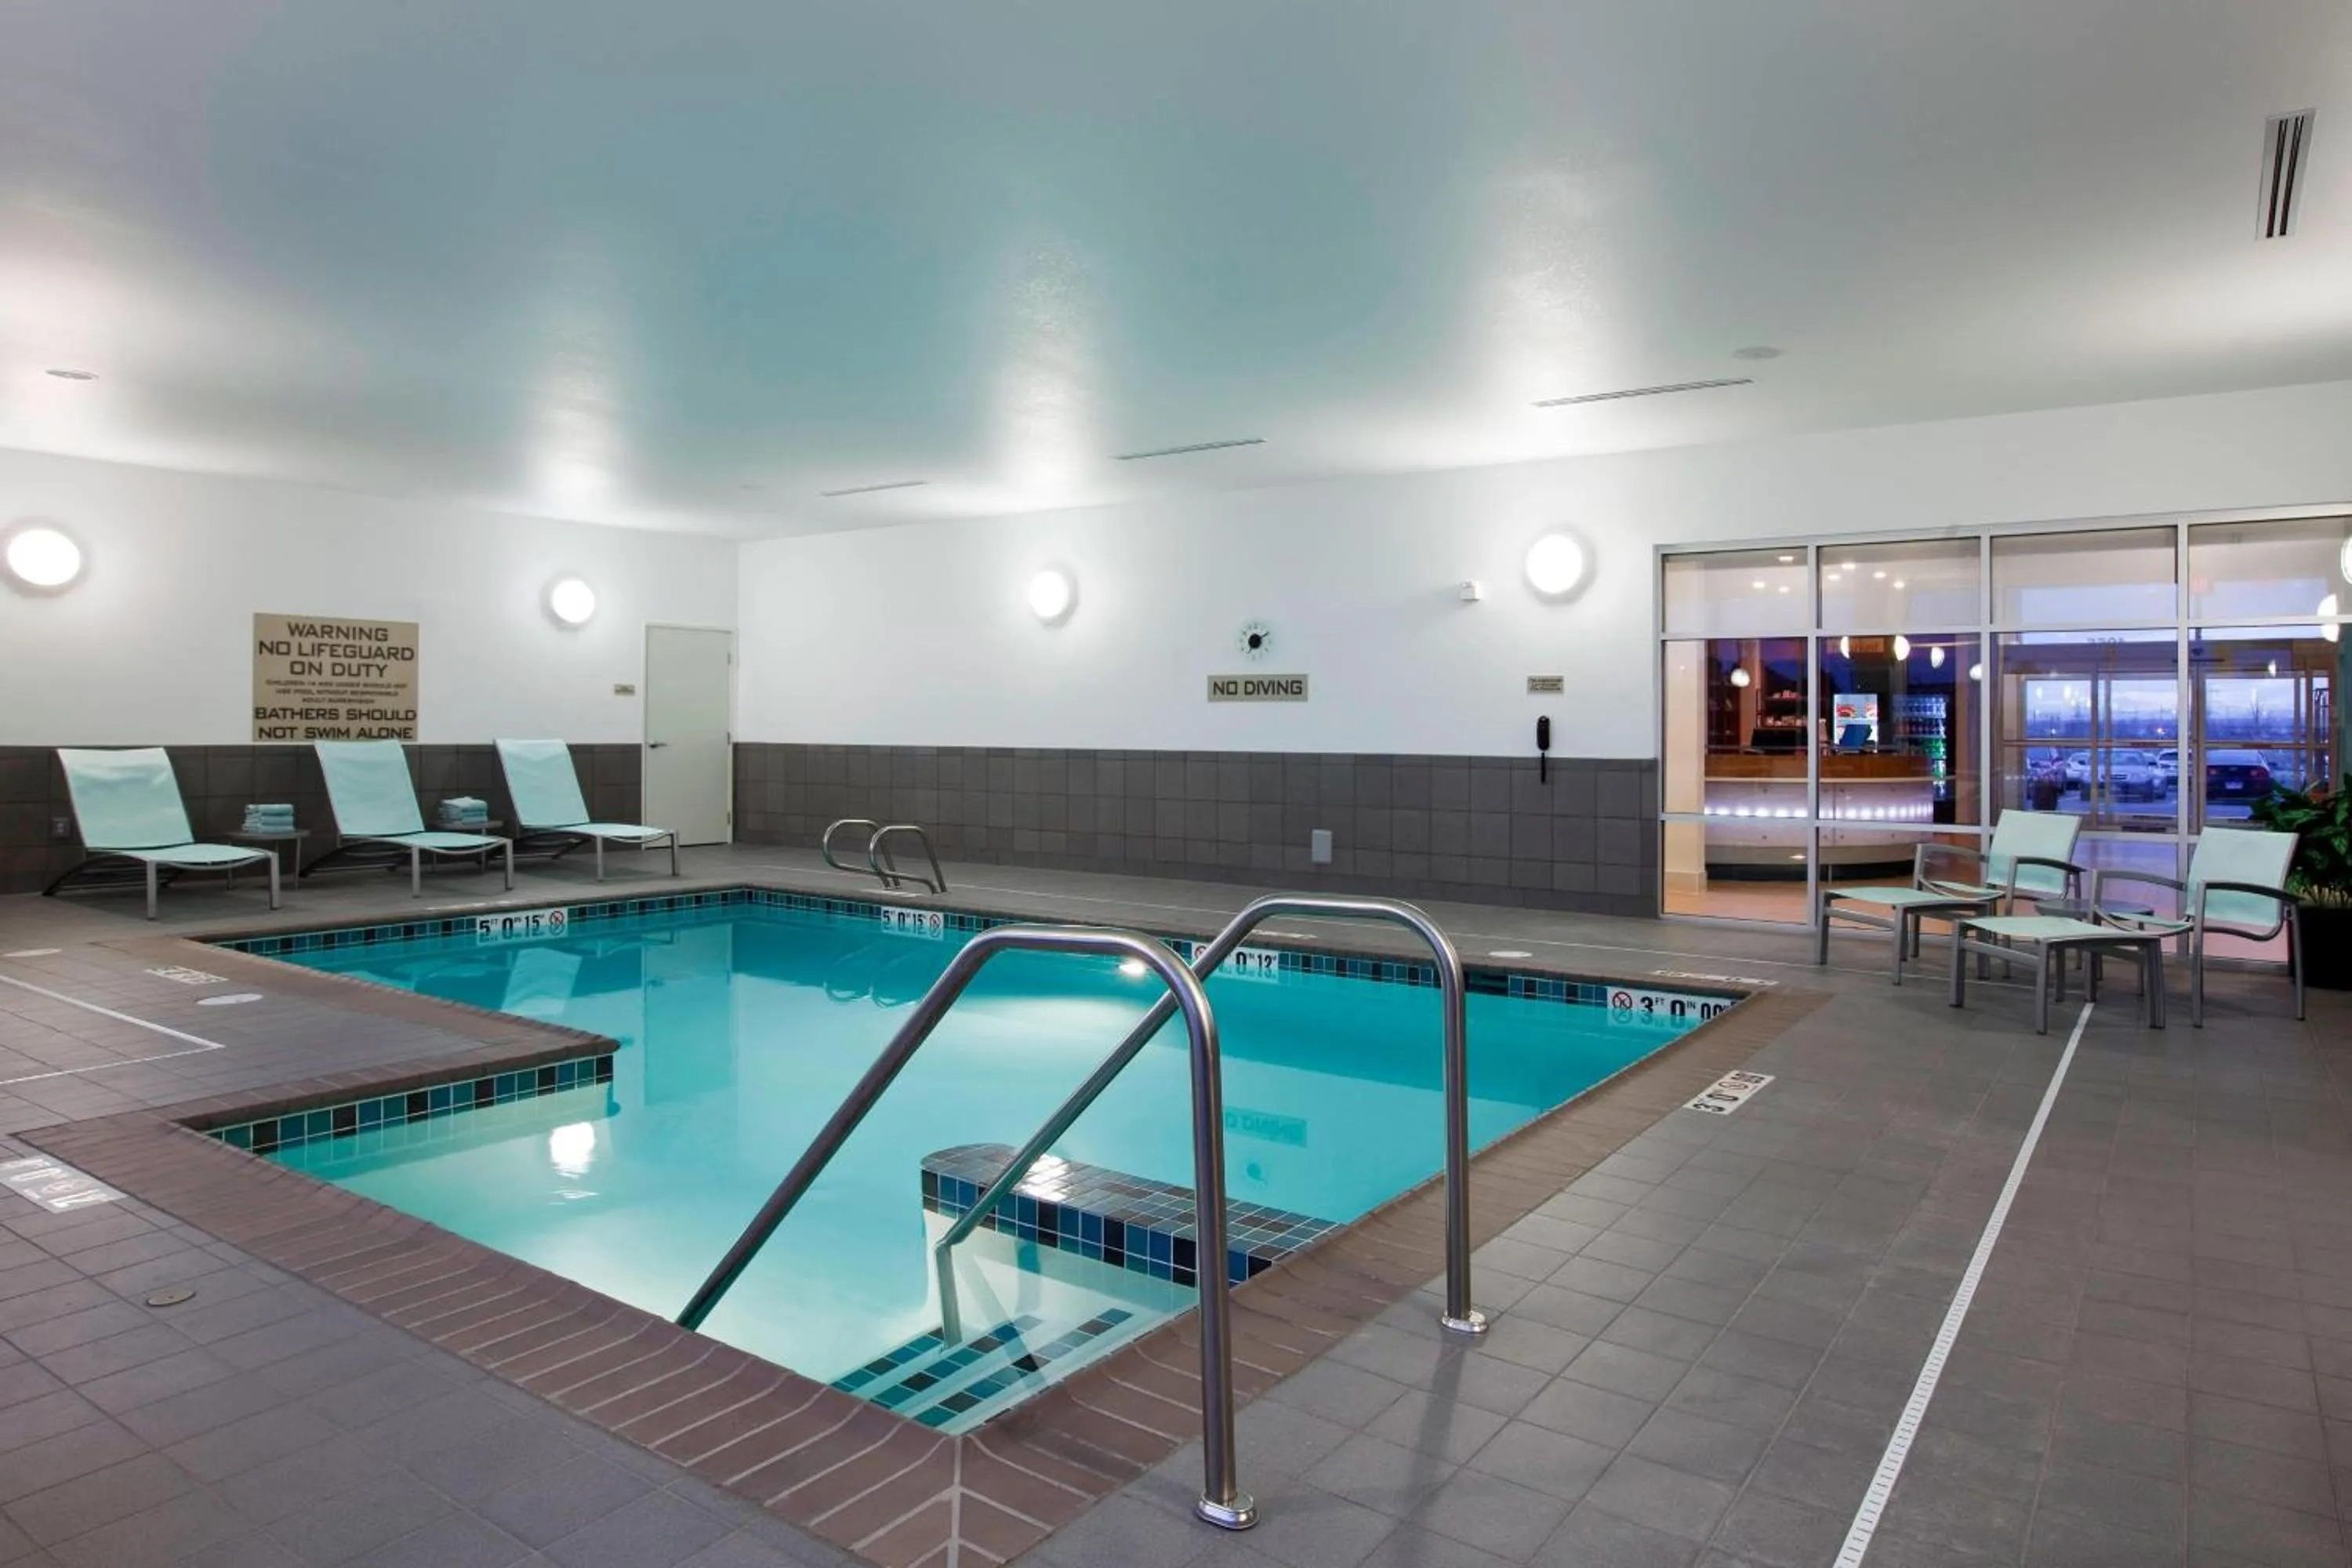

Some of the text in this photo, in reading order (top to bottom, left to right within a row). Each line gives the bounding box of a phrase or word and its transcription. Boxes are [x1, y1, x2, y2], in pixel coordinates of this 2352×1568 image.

[287, 622, 389, 642] WARNING
[259, 641, 415, 661] NO LIFEGUARD
[289, 661, 388, 677] ON DUTY
[1213, 680, 1302, 695] NO DIVING
[255, 706, 417, 721] BATHERS SHOULD
[259, 727, 413, 739] NOT SWIM ALONE
